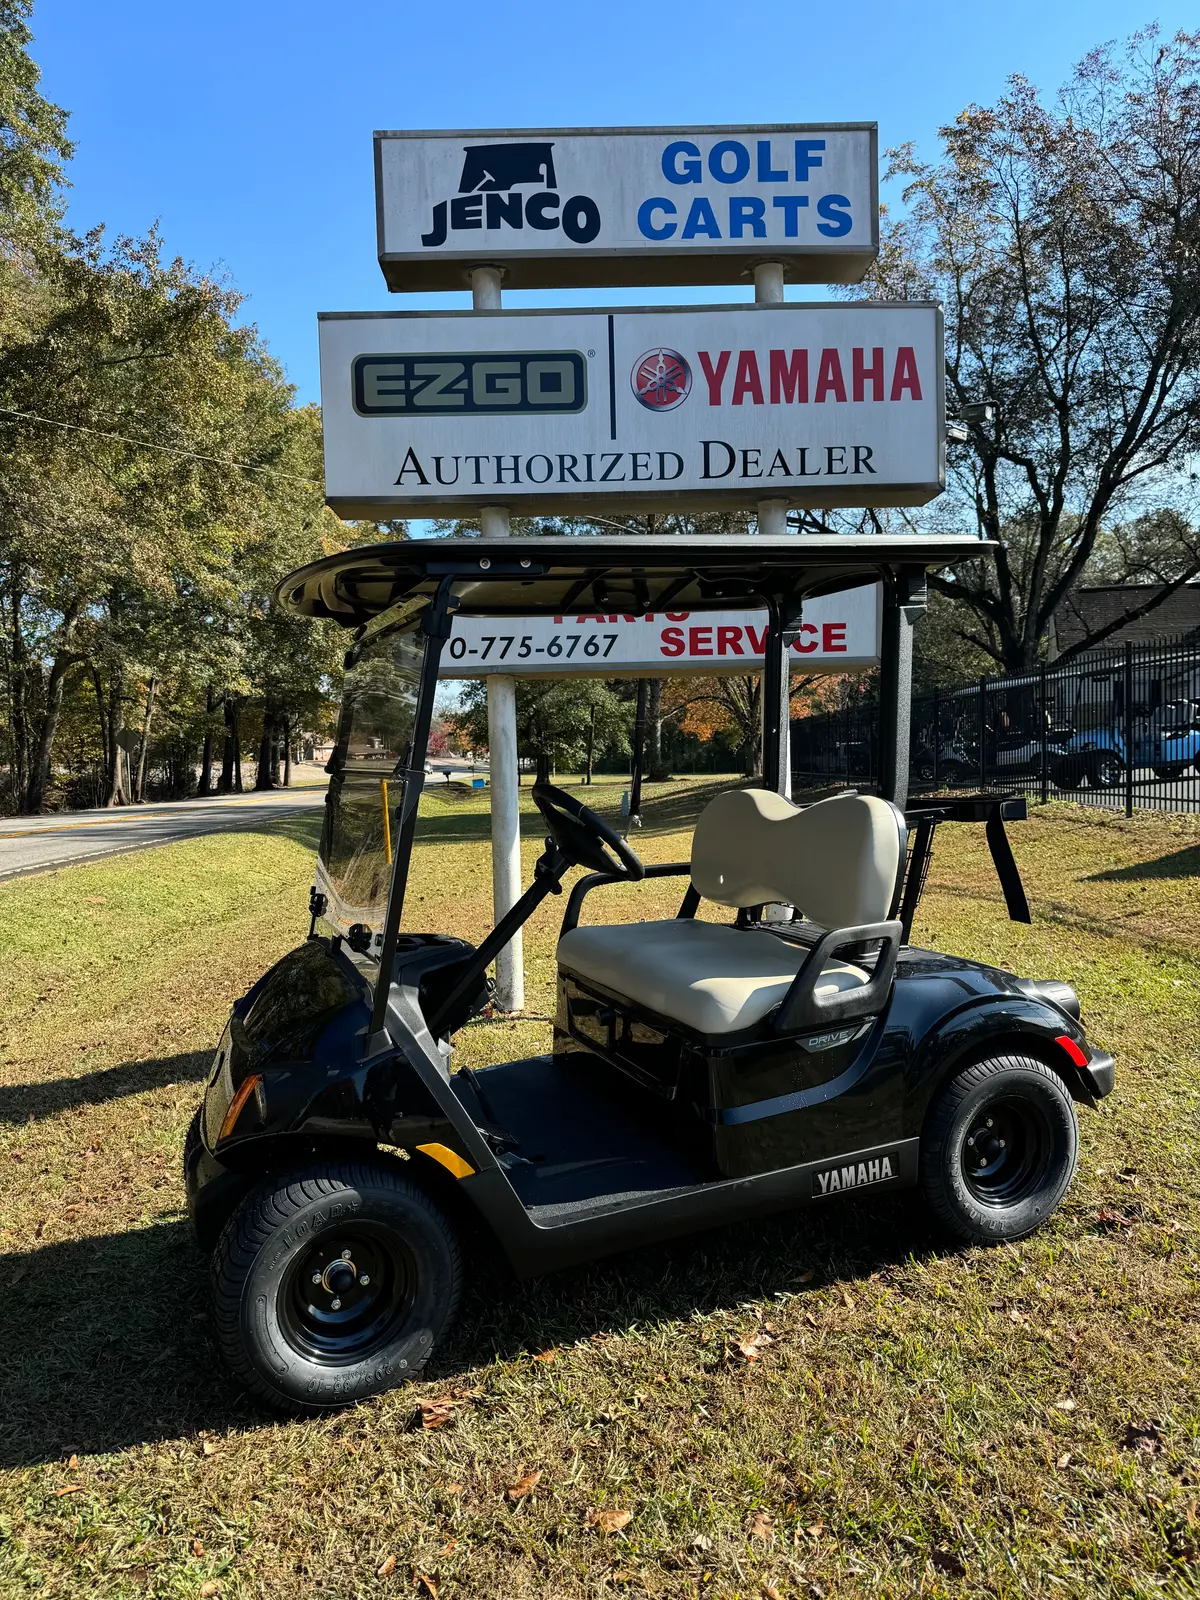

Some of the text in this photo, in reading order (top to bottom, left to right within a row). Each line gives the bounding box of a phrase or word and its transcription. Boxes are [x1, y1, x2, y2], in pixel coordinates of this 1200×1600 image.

[661, 140, 826, 185] GOLF
[421, 192, 602, 248] JENCO
[637, 194, 853, 241] CARTS
[697, 346, 923, 406] YAMAHA
[659, 622, 848, 657] SERVCE
[808, 1030, 849, 1046] DRIVE
[816, 1156, 893, 1194] YAMAHA
